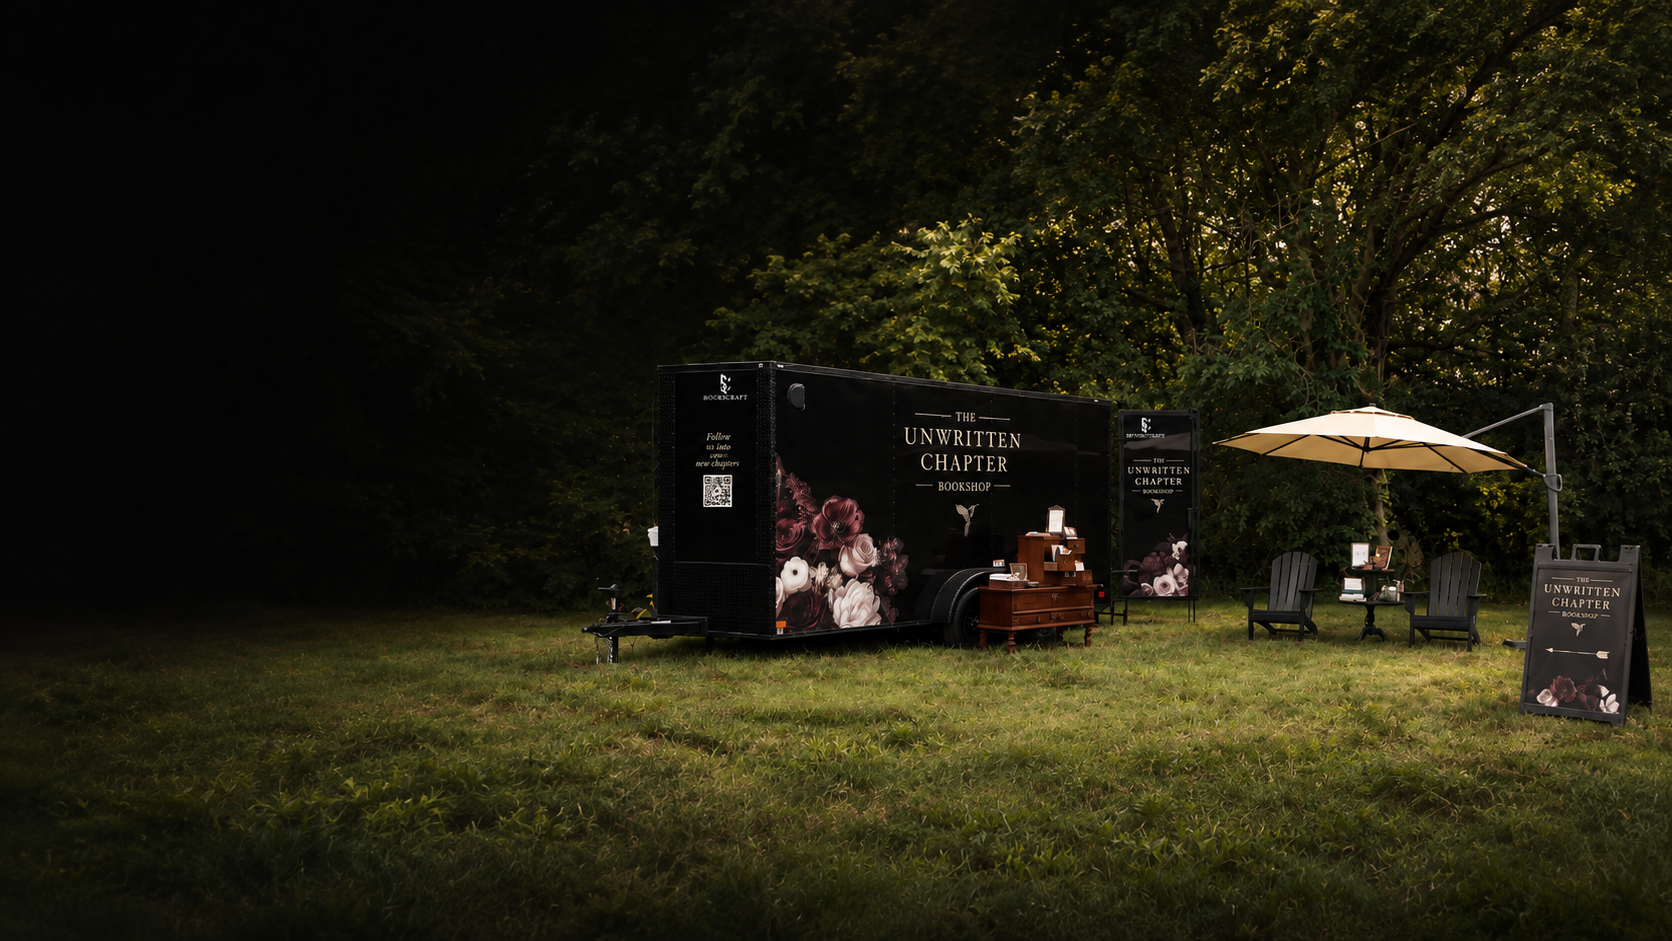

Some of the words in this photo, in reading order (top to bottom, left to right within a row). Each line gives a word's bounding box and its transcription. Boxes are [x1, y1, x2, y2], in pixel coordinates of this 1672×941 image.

[955, 411, 977, 423] THE
[706, 432, 732, 441] Follow
[904, 426, 1021, 449] UNWRITTEN
[711, 458, 740, 471] chapters
[920, 452, 1008, 473] CHAPTER
[1127, 466, 1191, 475] UNWRITTEN
[938, 481, 992, 492] BOOKSHOP
[1134, 477, 1183, 486] CHAPTER
[1544, 583, 1621, 597] UNWRITTEN
[1551, 597, 1610, 610] CHAPTER
[1561, 611, 1599, 619] BOOKSHOP
